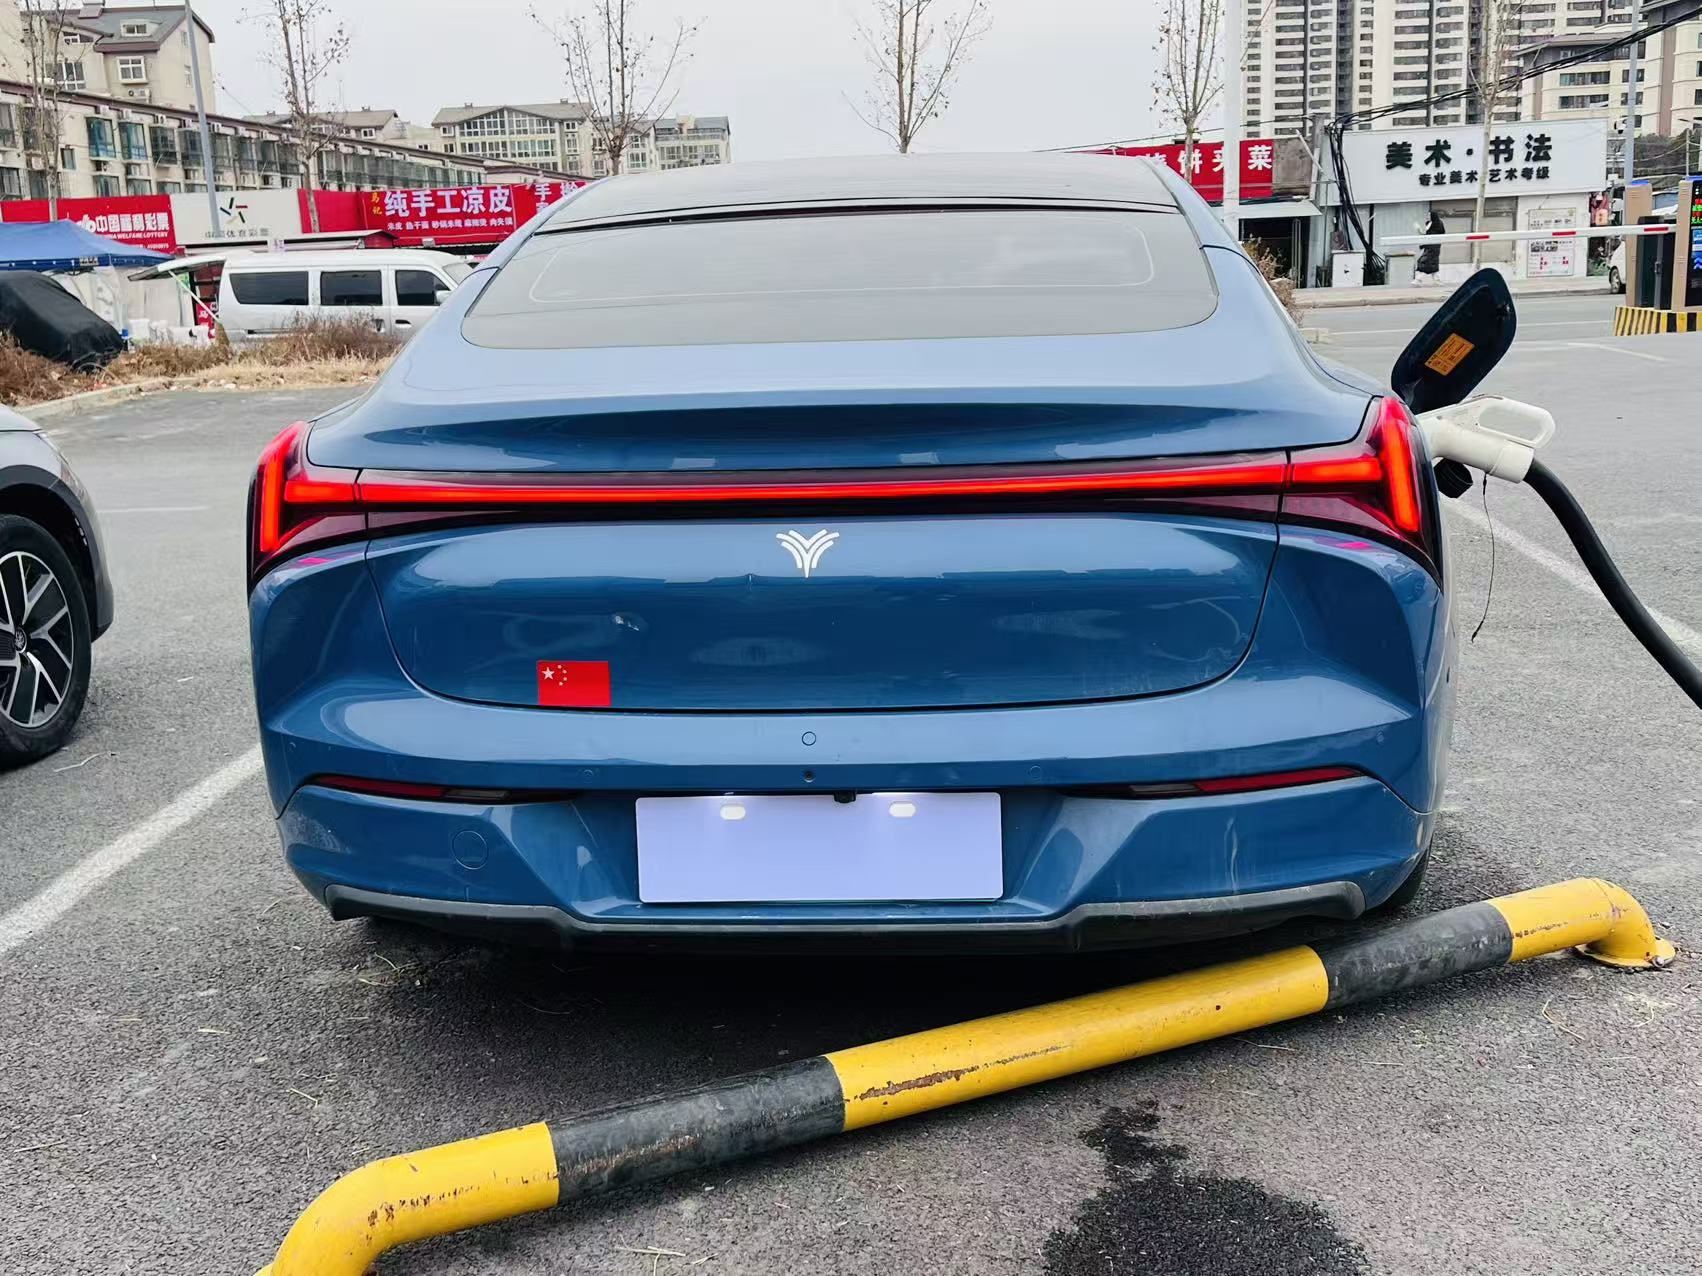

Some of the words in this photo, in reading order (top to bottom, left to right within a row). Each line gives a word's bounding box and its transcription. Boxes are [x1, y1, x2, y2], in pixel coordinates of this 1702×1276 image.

[1386, 133, 1552, 170] 美术·书法
[1488, 166, 1550, 183] 艺术考级
[384, 184, 513, 217] 纯手工凉皮
[95, 212, 170, 233] 中国福利彩票
